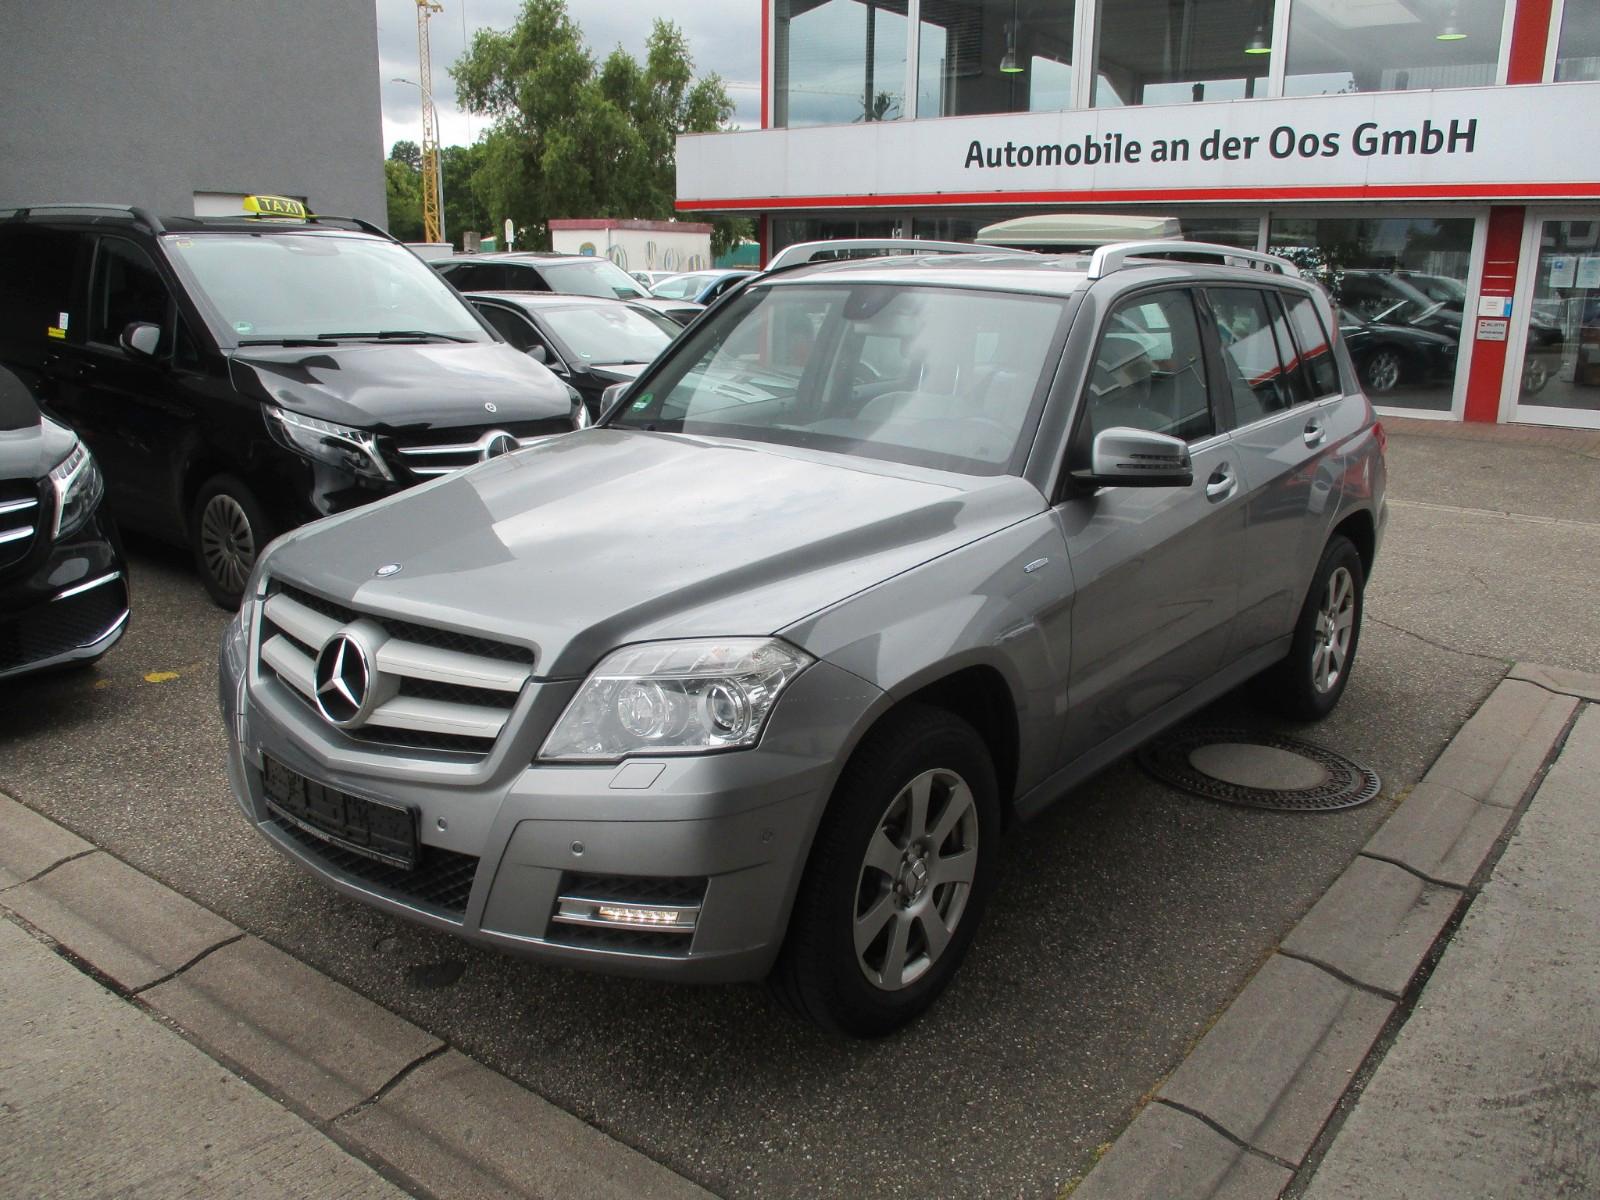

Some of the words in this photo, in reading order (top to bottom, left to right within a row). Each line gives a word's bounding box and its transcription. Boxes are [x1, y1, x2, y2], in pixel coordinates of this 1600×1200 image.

[964, 133, 1142, 169] Automobile
[1150, 139, 1190, 163] an
[1199, 129, 1260, 161] der
[1268, 125, 1340, 159] Oos
[1351, 118, 1478, 156] GmbH
[261, 198, 299, 214] TAXI
